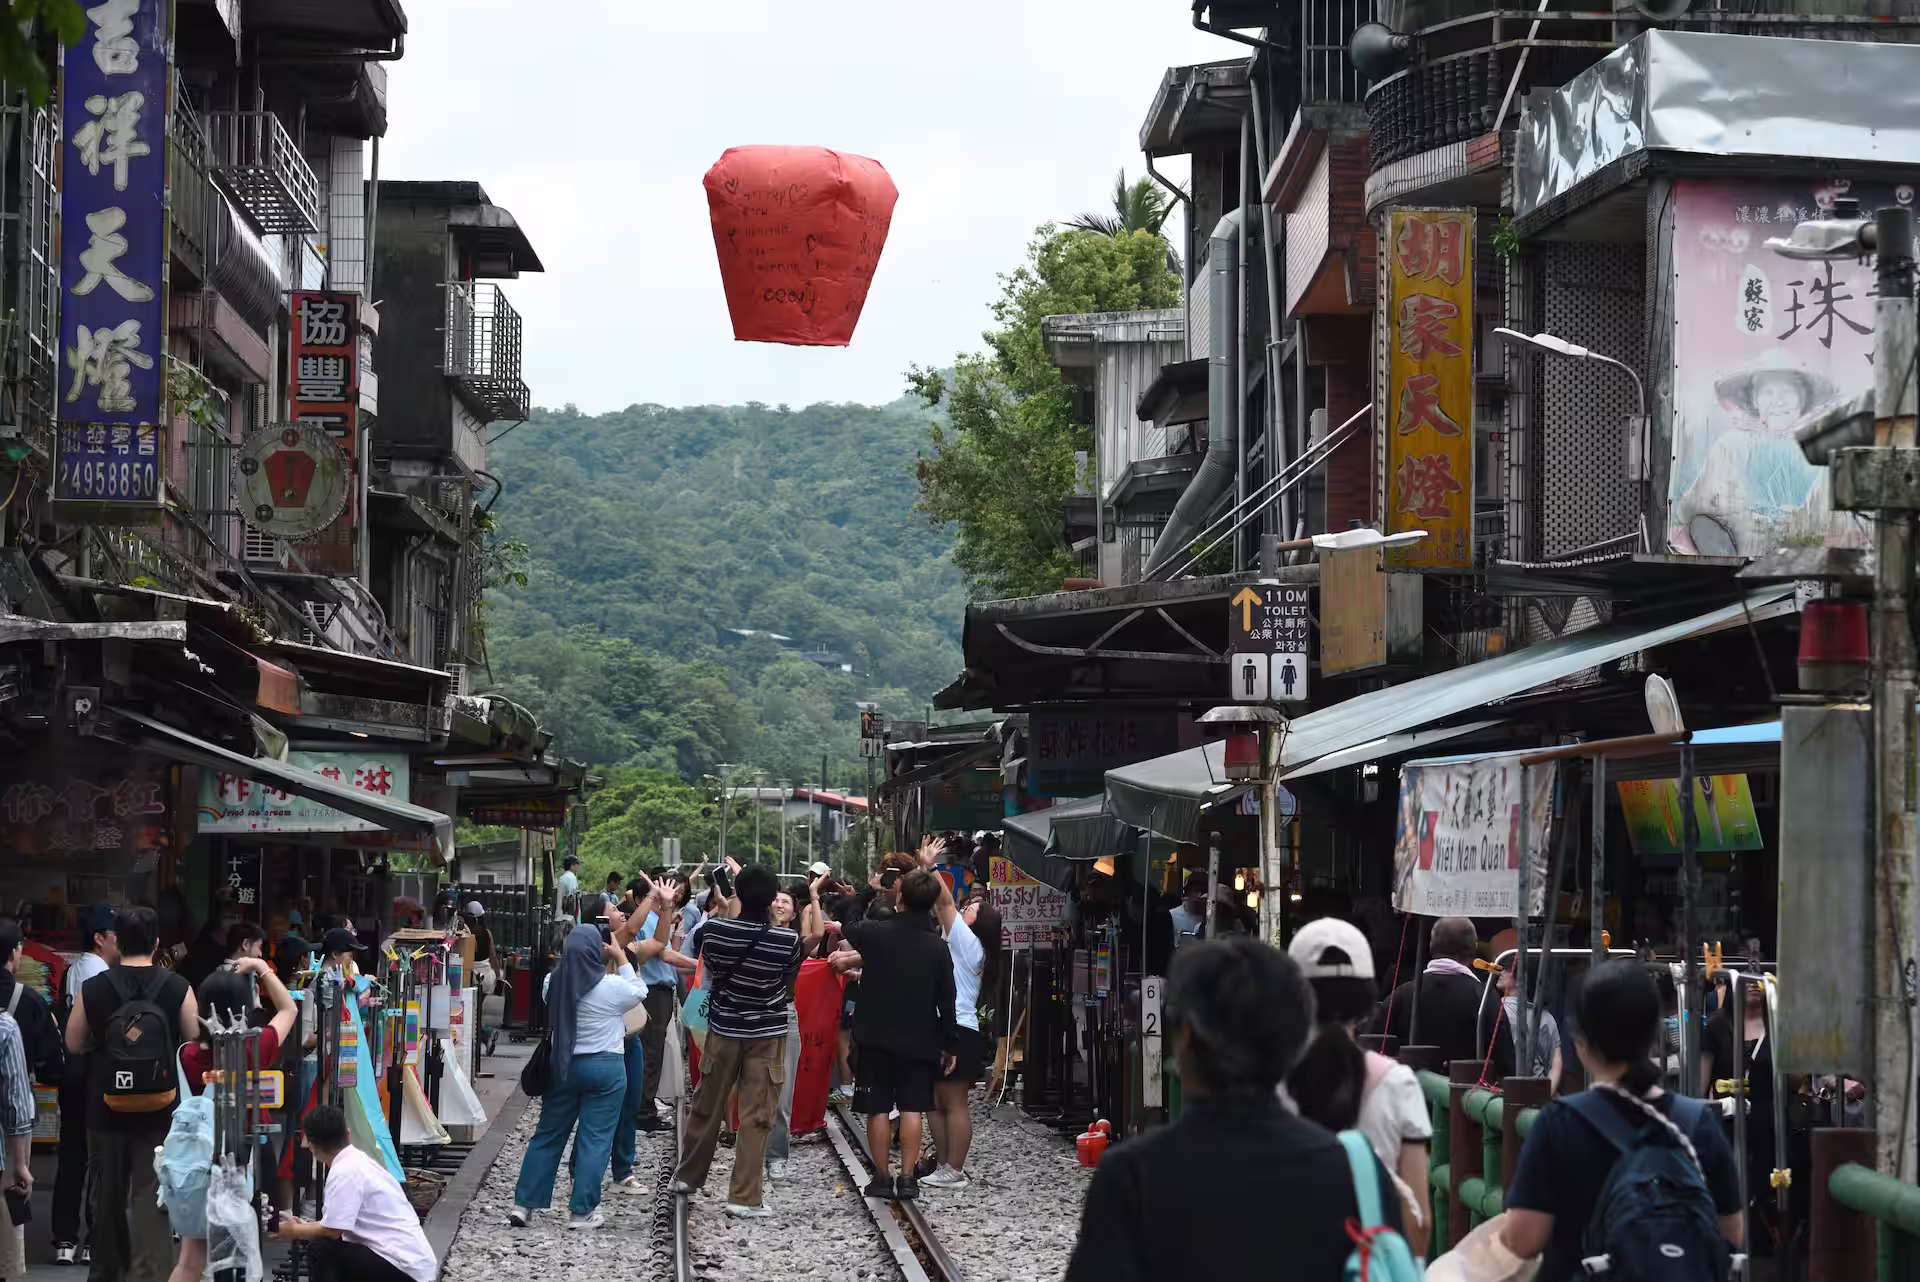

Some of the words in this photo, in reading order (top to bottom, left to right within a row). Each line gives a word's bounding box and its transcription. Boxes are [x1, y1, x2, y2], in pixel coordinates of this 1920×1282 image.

[1744, 278, 1768, 332] 蘇家
[1395, 216, 1466, 520] 胡家天燈
[1265, 590, 1307, 602] 110M
[1264, 606, 1307, 616] TOILET
[1262, 618, 1307, 628] 公共廁所
[1275, 641, 1307, 652] 화장실
[215, 765, 392, 803] 炸淋
[1456, 838, 1477, 873] Nam
